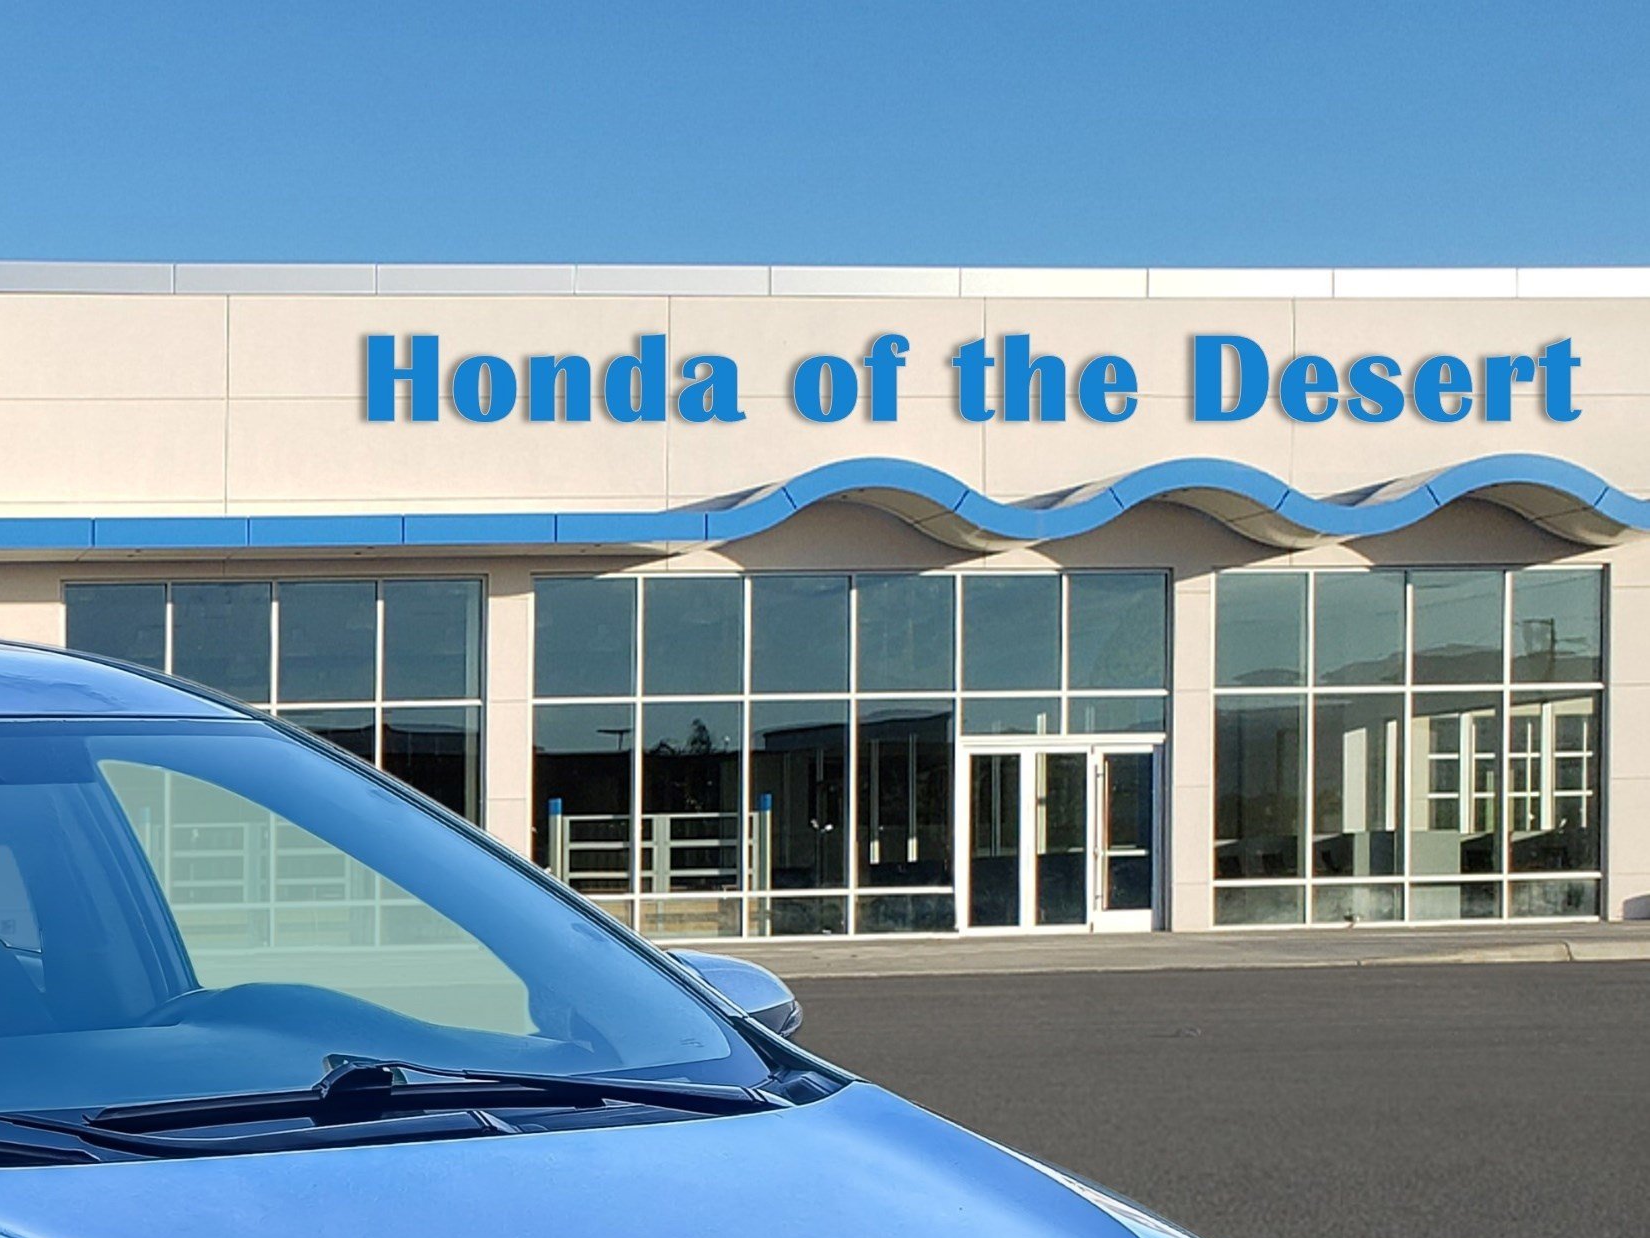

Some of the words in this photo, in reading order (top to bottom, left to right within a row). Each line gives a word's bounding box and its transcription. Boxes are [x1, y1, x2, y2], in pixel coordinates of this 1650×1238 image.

[365, 333, 747, 423] Honda
[792, 333, 910, 423] of
[951, 333, 1138, 423] the
[1193, 334, 1582, 423] Desert
